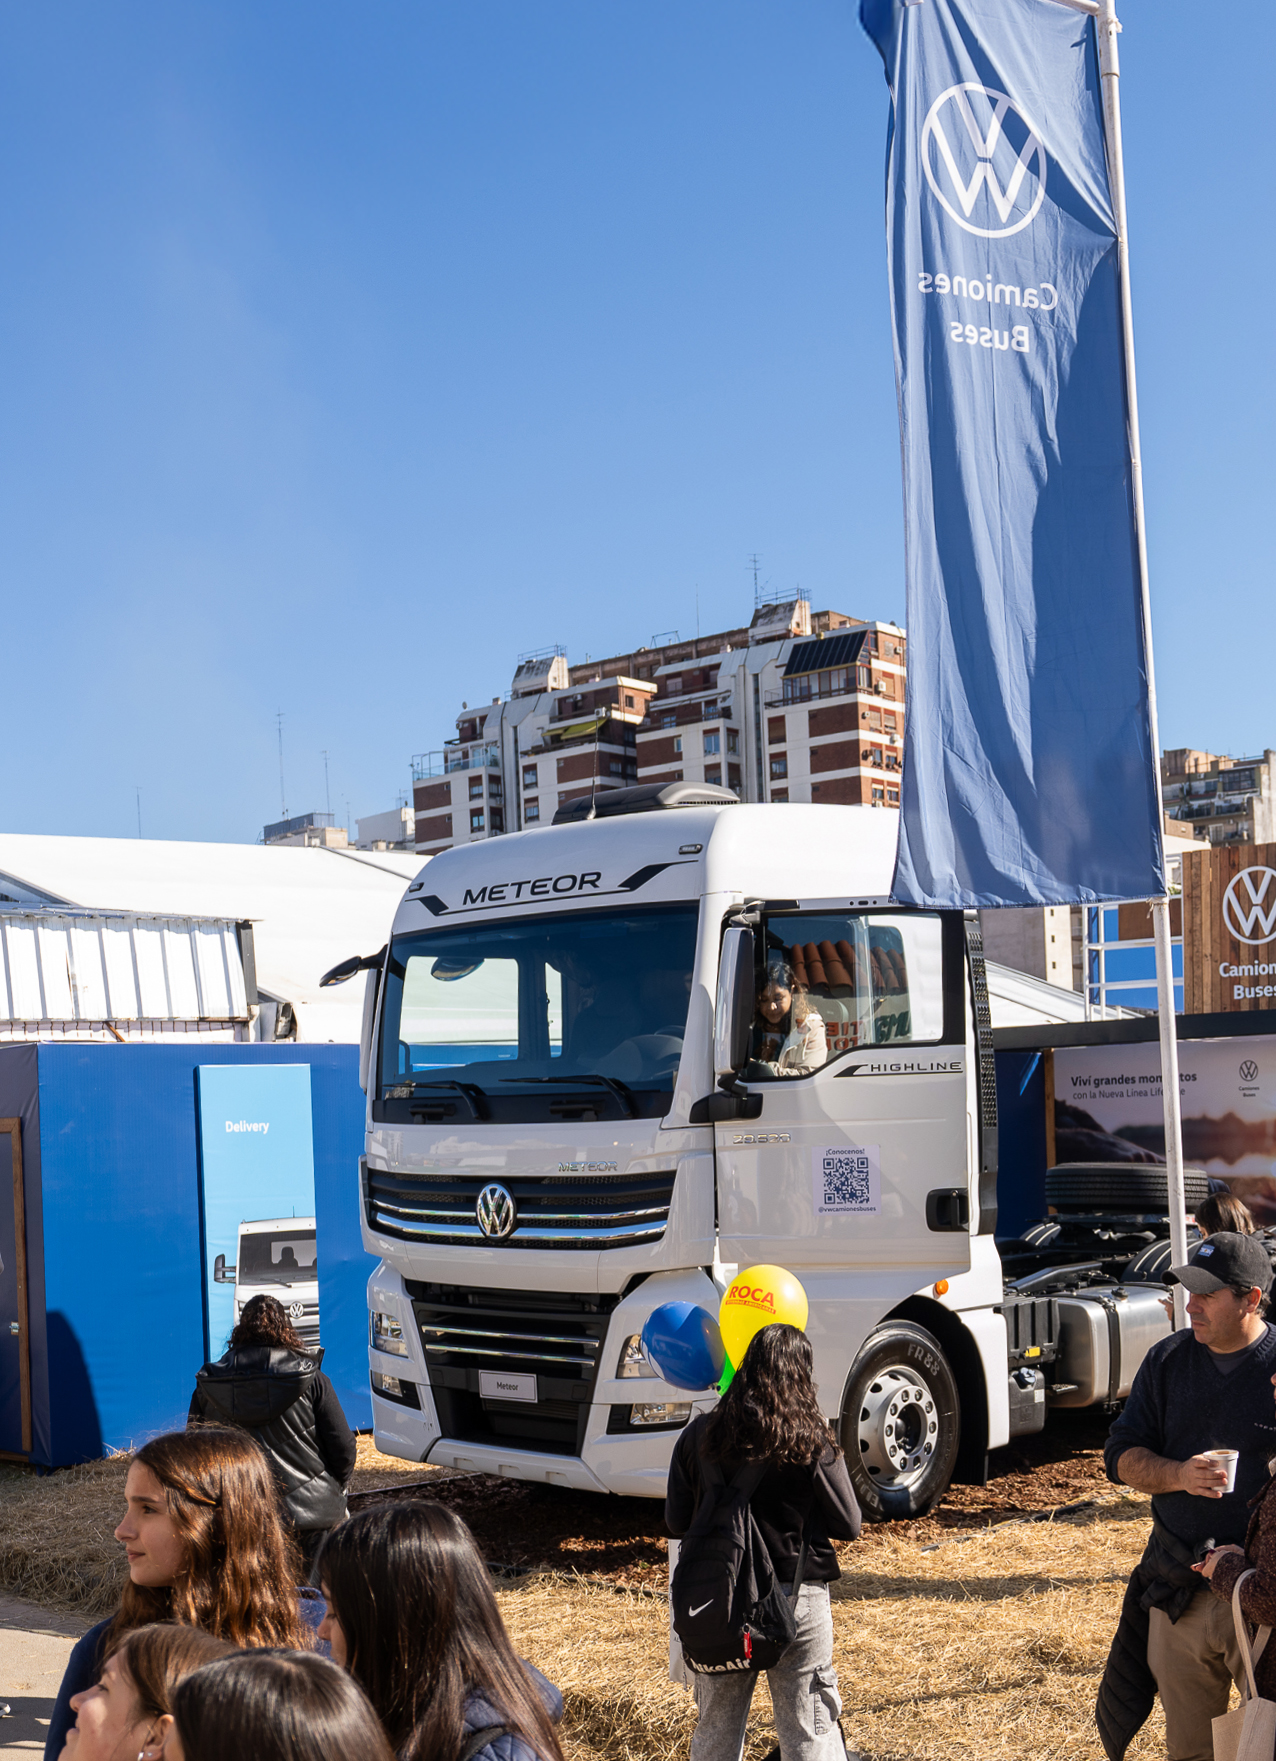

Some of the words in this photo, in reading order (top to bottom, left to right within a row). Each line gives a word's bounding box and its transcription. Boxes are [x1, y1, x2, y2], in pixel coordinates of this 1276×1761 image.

[462, 871, 602, 905] METEOR
[870, 1061, 962, 1073] HIGHLINE
[1071, 1075, 1091, 1086] Viví
[1093, 1074, 1136, 1088] grandes
[1072, 1091, 1088, 1100] con
[1089, 1089, 1097, 1099] la
[1099, 1088, 1125, 1098] Nueva
[225, 1120, 269, 1135] Delivery
[826, 1148, 865, 1156] ¡Conocenos!
[558, 1160, 618, 1172] METEOR
[818, 1205, 876, 1213] @vwcamionesbuses
[729, 1285, 774, 1307] ROCA
[496, 1381, 519, 1390] Meteor
